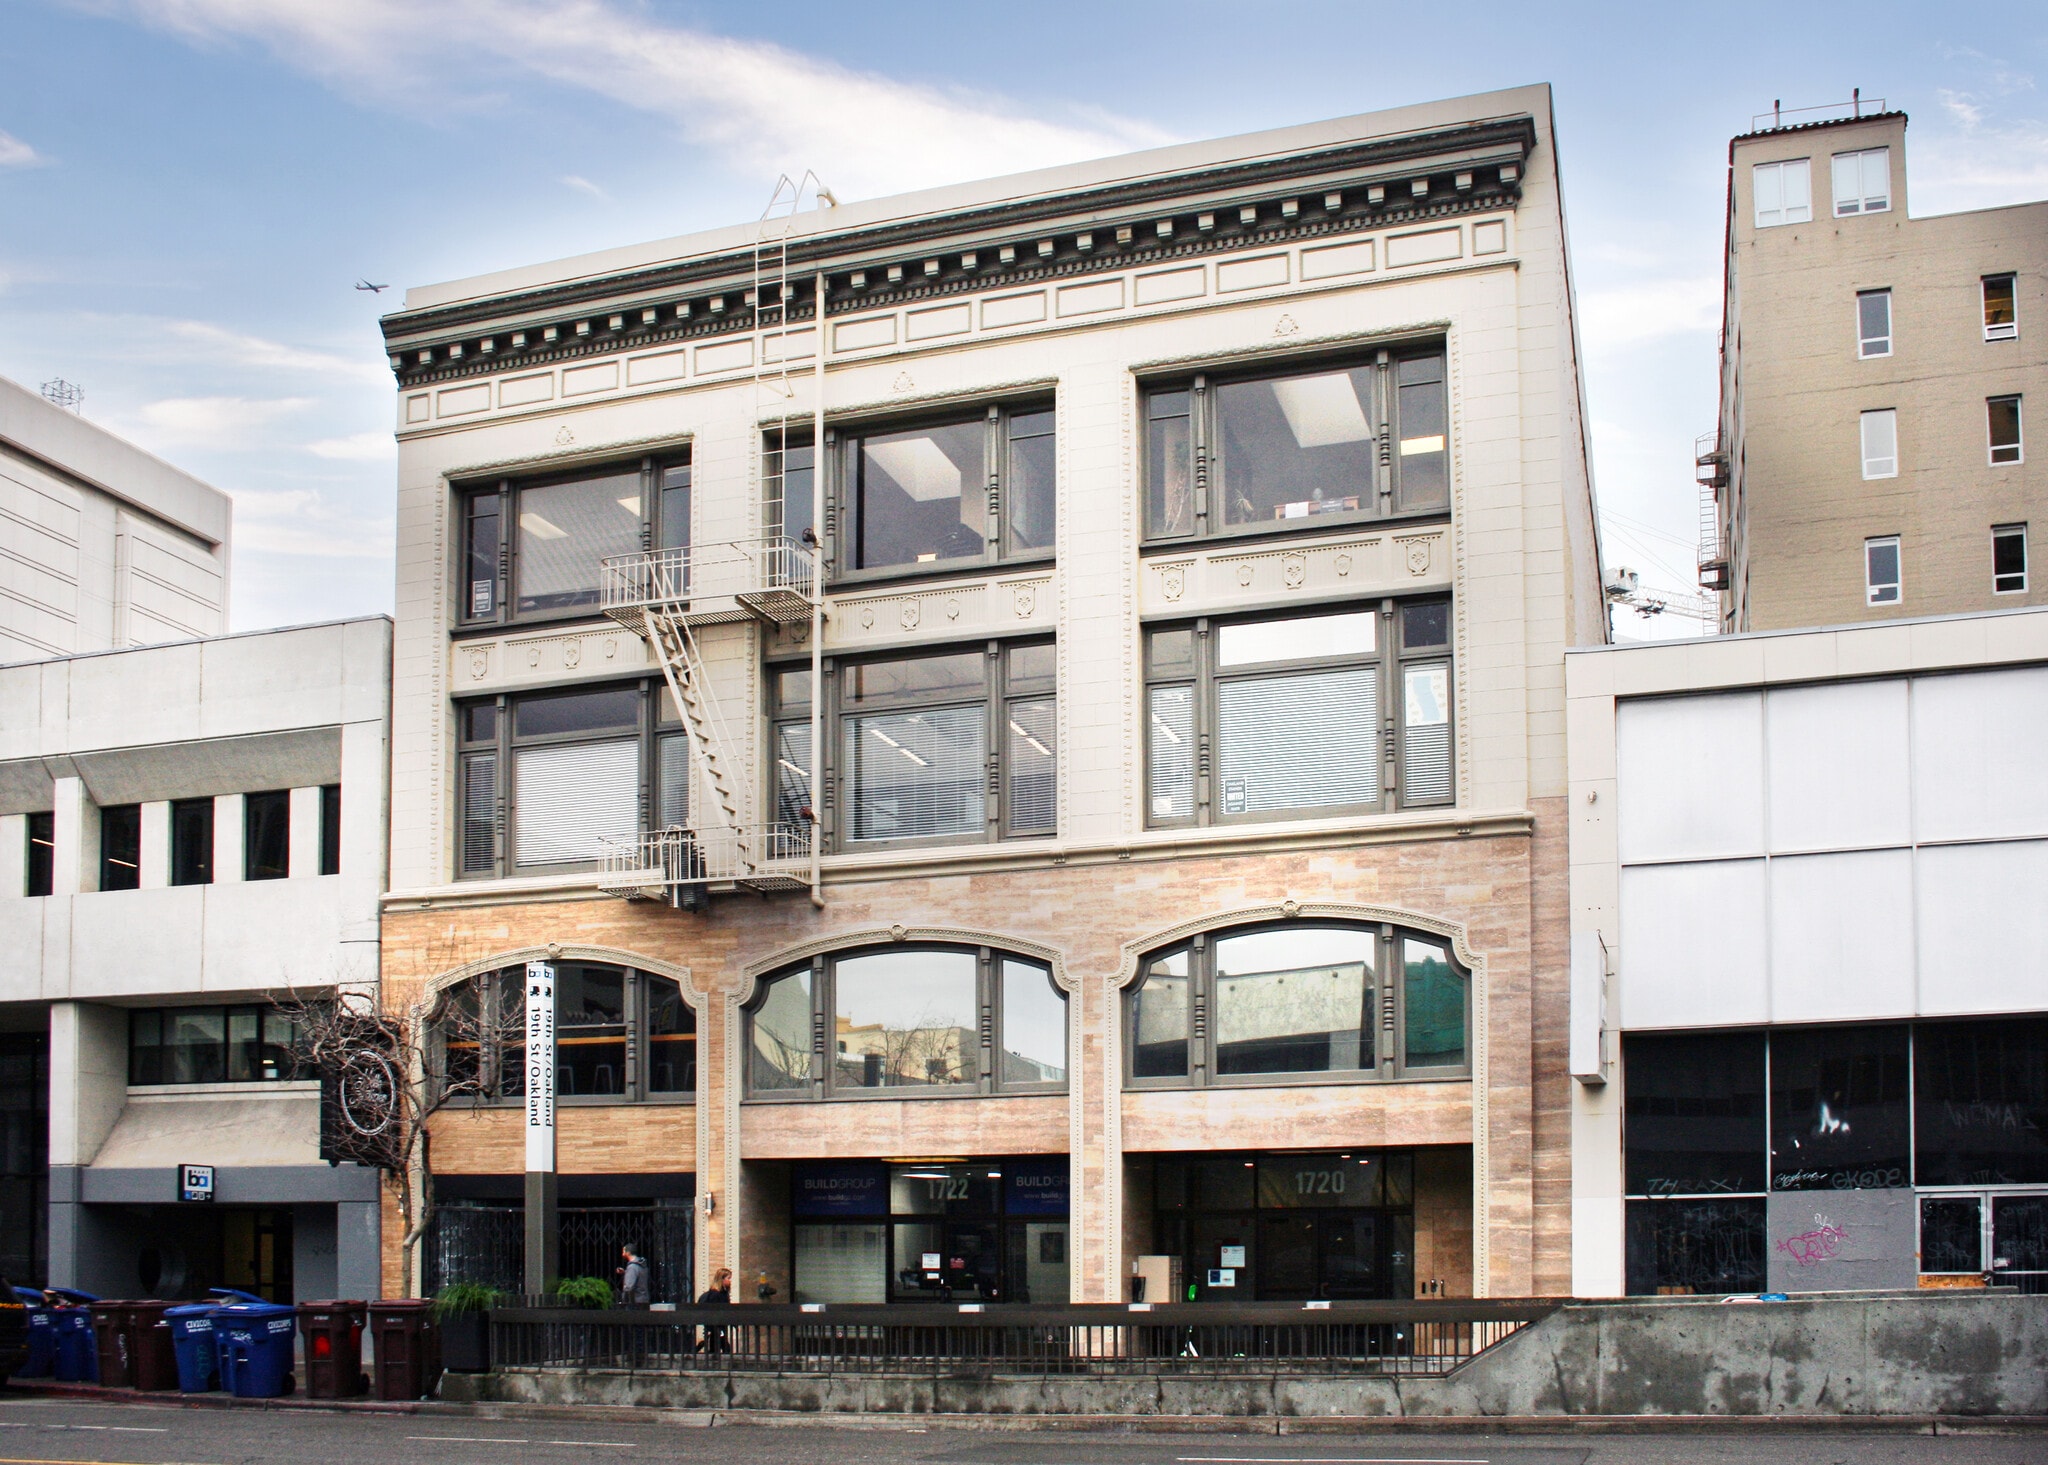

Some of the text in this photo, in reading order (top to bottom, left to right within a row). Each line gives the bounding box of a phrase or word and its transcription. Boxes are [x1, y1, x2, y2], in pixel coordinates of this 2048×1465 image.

[531, 1007, 541, 1037] 19th
[928, 1179, 968, 1200] 1722
[1016, 1176, 1069, 1187] BUILDGR
[1295, 1171, 1345, 1193] 1720
